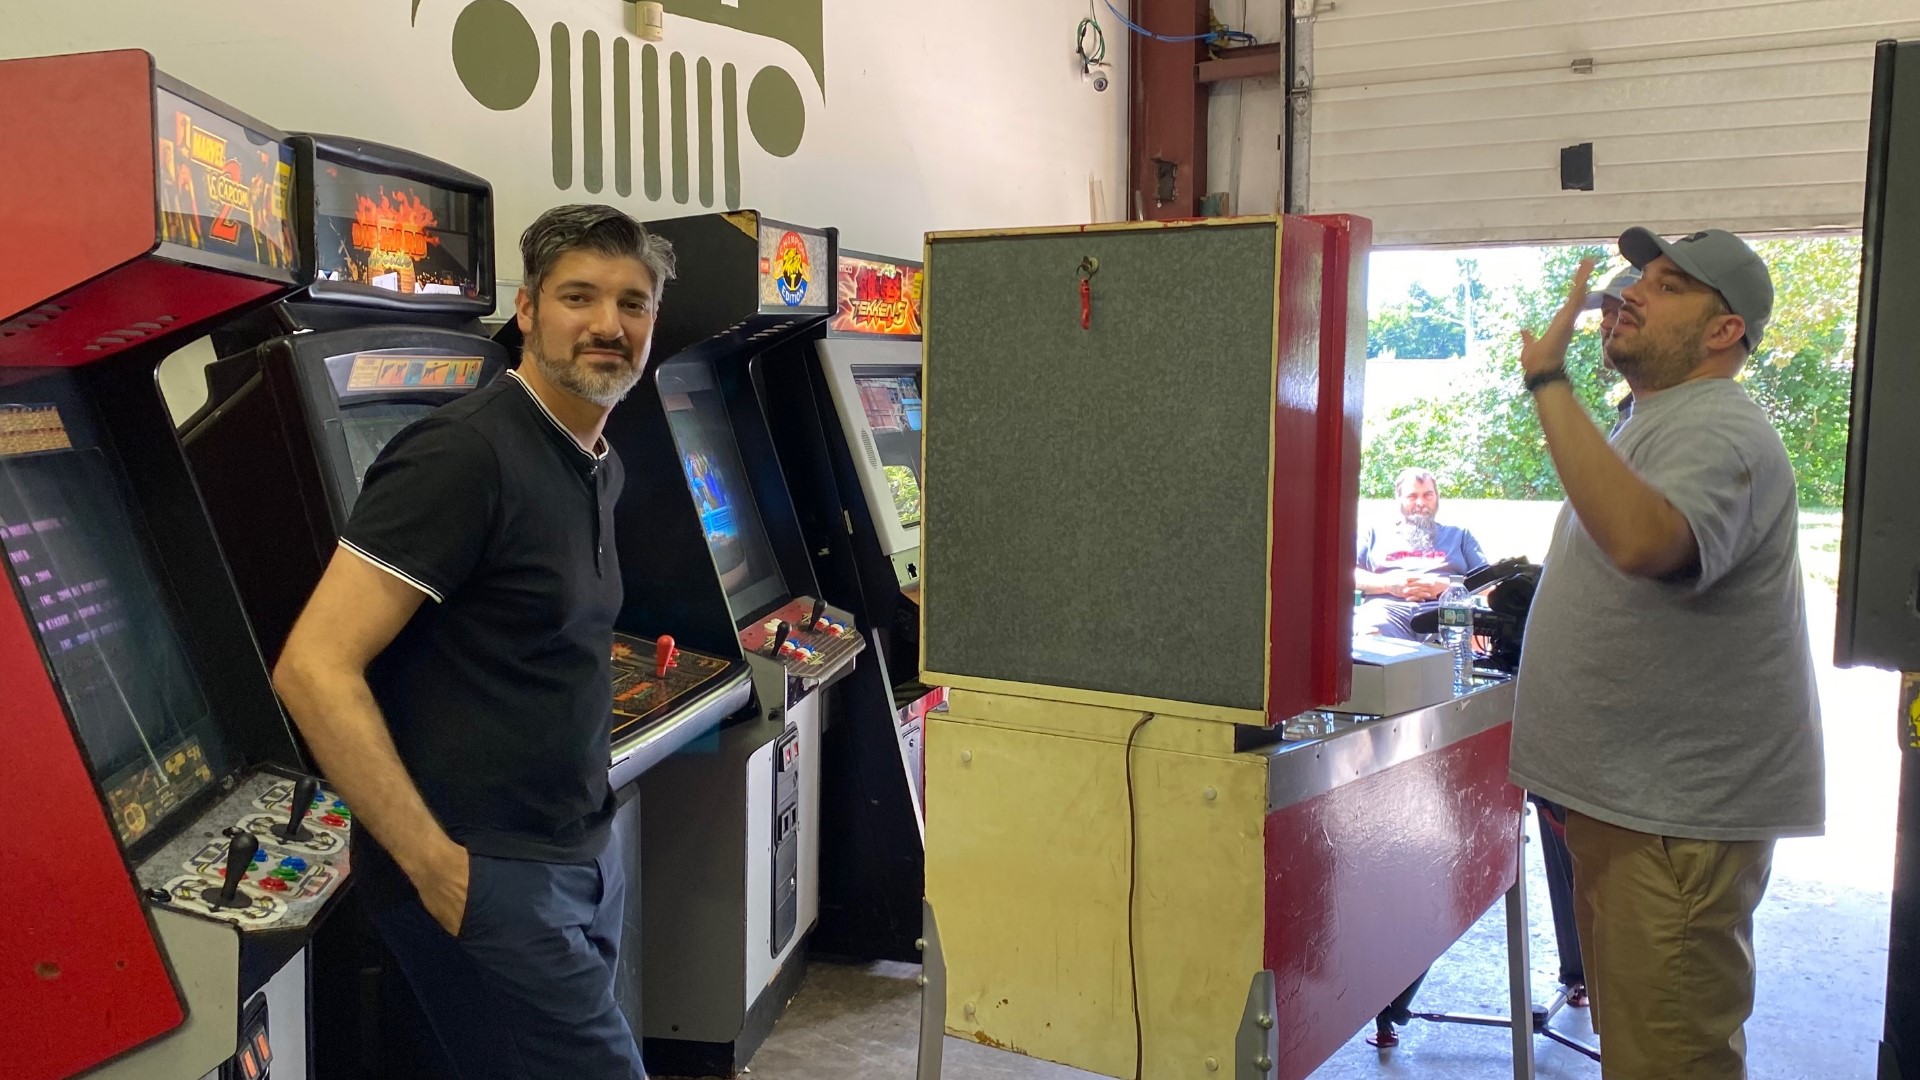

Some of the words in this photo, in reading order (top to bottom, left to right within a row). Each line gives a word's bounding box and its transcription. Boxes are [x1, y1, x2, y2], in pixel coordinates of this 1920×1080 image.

[192, 131, 226, 169] MARVEL
[218, 179, 250, 208] CAPCOM
[379, 225, 428, 260] HARD
[781, 284, 804, 304] EDITION
[849, 298, 895, 320] TEKKEN
[893, 301, 908, 325] 5
